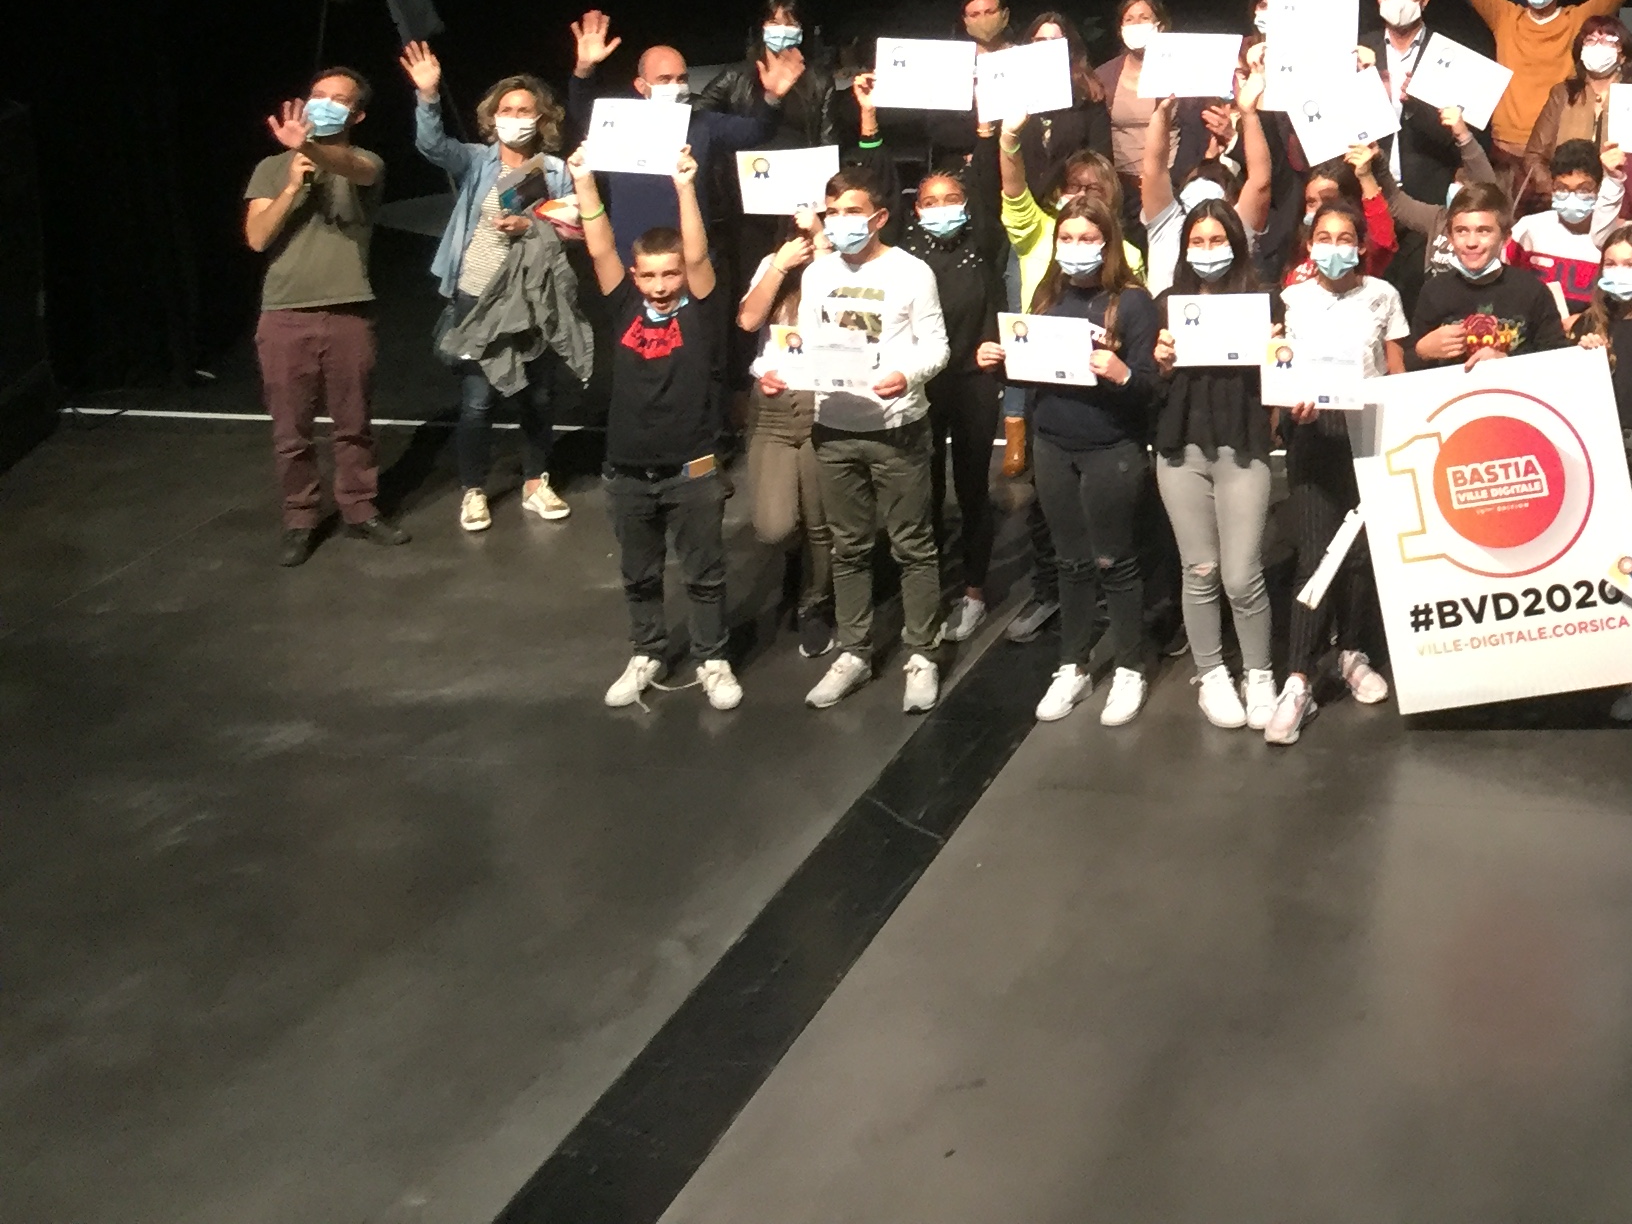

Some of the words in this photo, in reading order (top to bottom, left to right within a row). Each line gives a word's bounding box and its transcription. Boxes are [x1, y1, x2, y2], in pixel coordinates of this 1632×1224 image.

[1452, 459, 1539, 488] BASTIA
[1458, 489, 1488, 502] VILLE
[1490, 481, 1541, 498] DIGITALE
[1417, 615, 1631, 656] VILLE-DIGITALE.CORSICA
